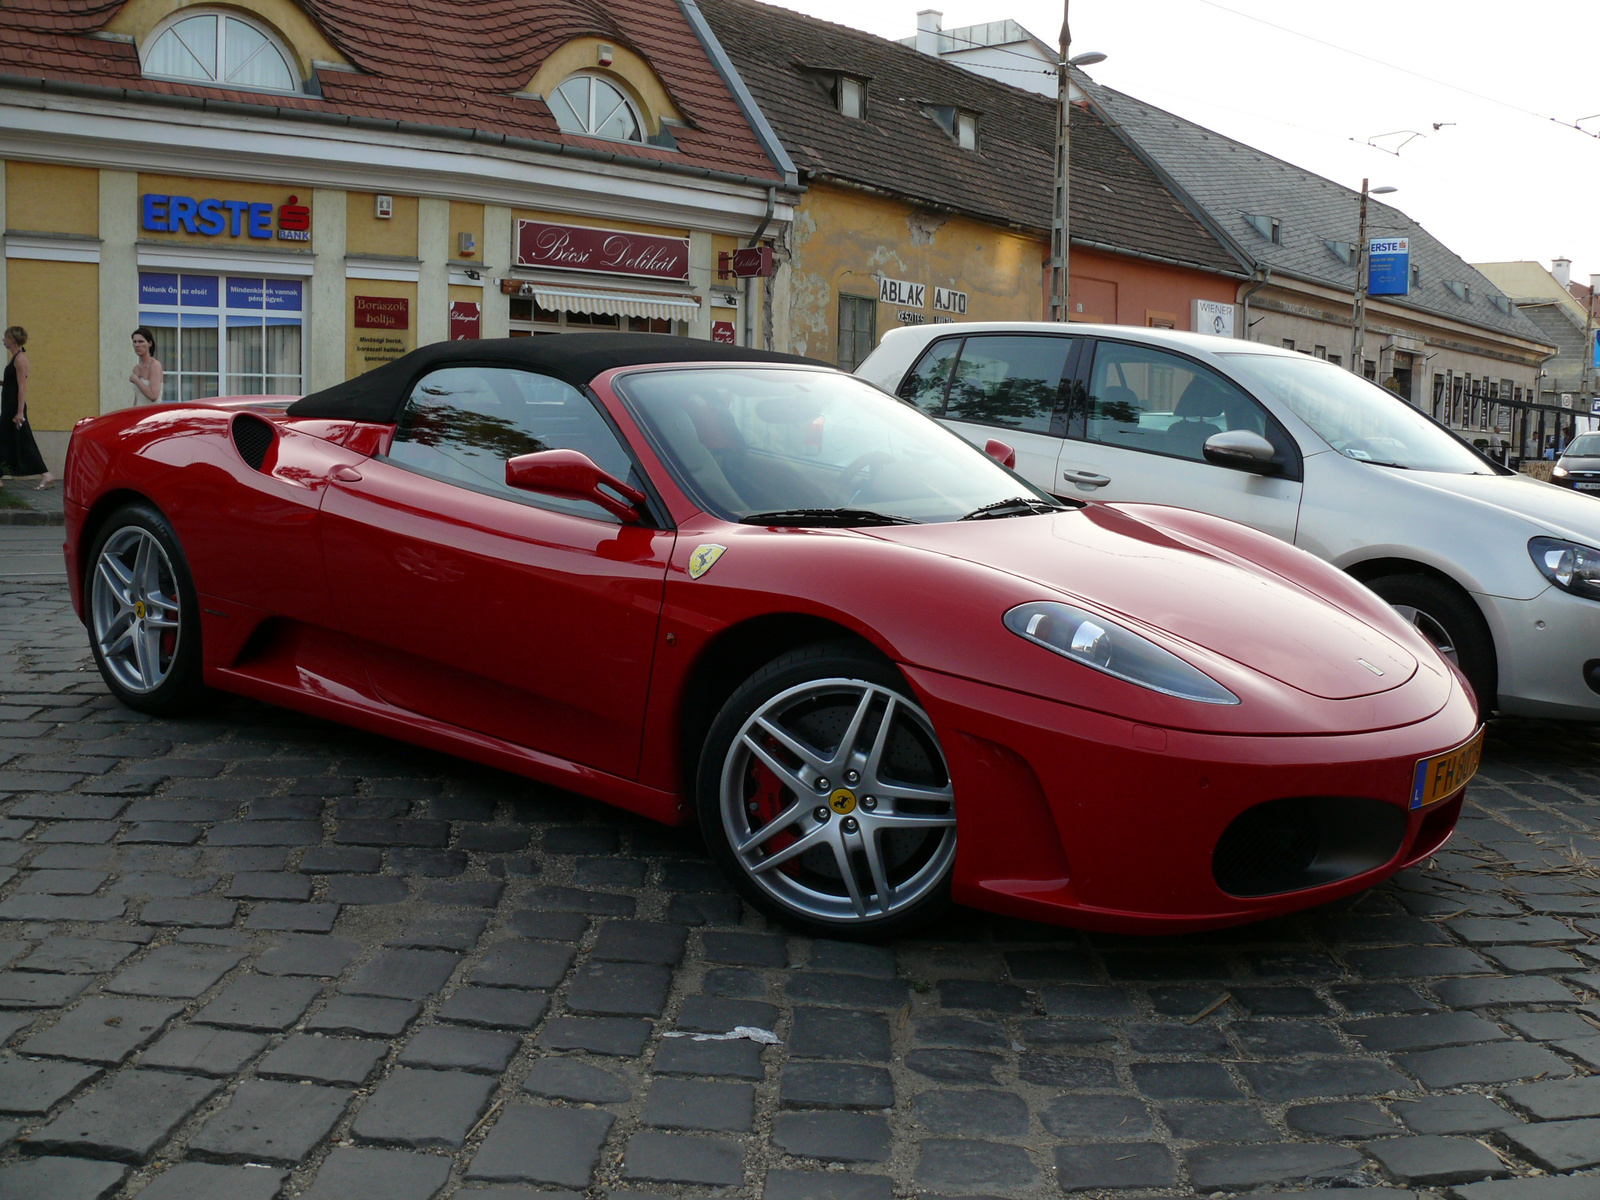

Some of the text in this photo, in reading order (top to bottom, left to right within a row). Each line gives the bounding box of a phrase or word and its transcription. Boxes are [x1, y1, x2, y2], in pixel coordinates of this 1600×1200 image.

[142, 193, 273, 239] ERSTE
[279, 230, 310, 240] BANK
[531, 227, 678, 273] Bécsi Delikát
[1371, 243, 1398, 252] ERSTE
[881, 280, 924, 307] ABLAK
[357, 299, 406, 312] Borászok
[1200, 302, 1232, 316] WIENER
[366, 313, 395, 326] boltja
